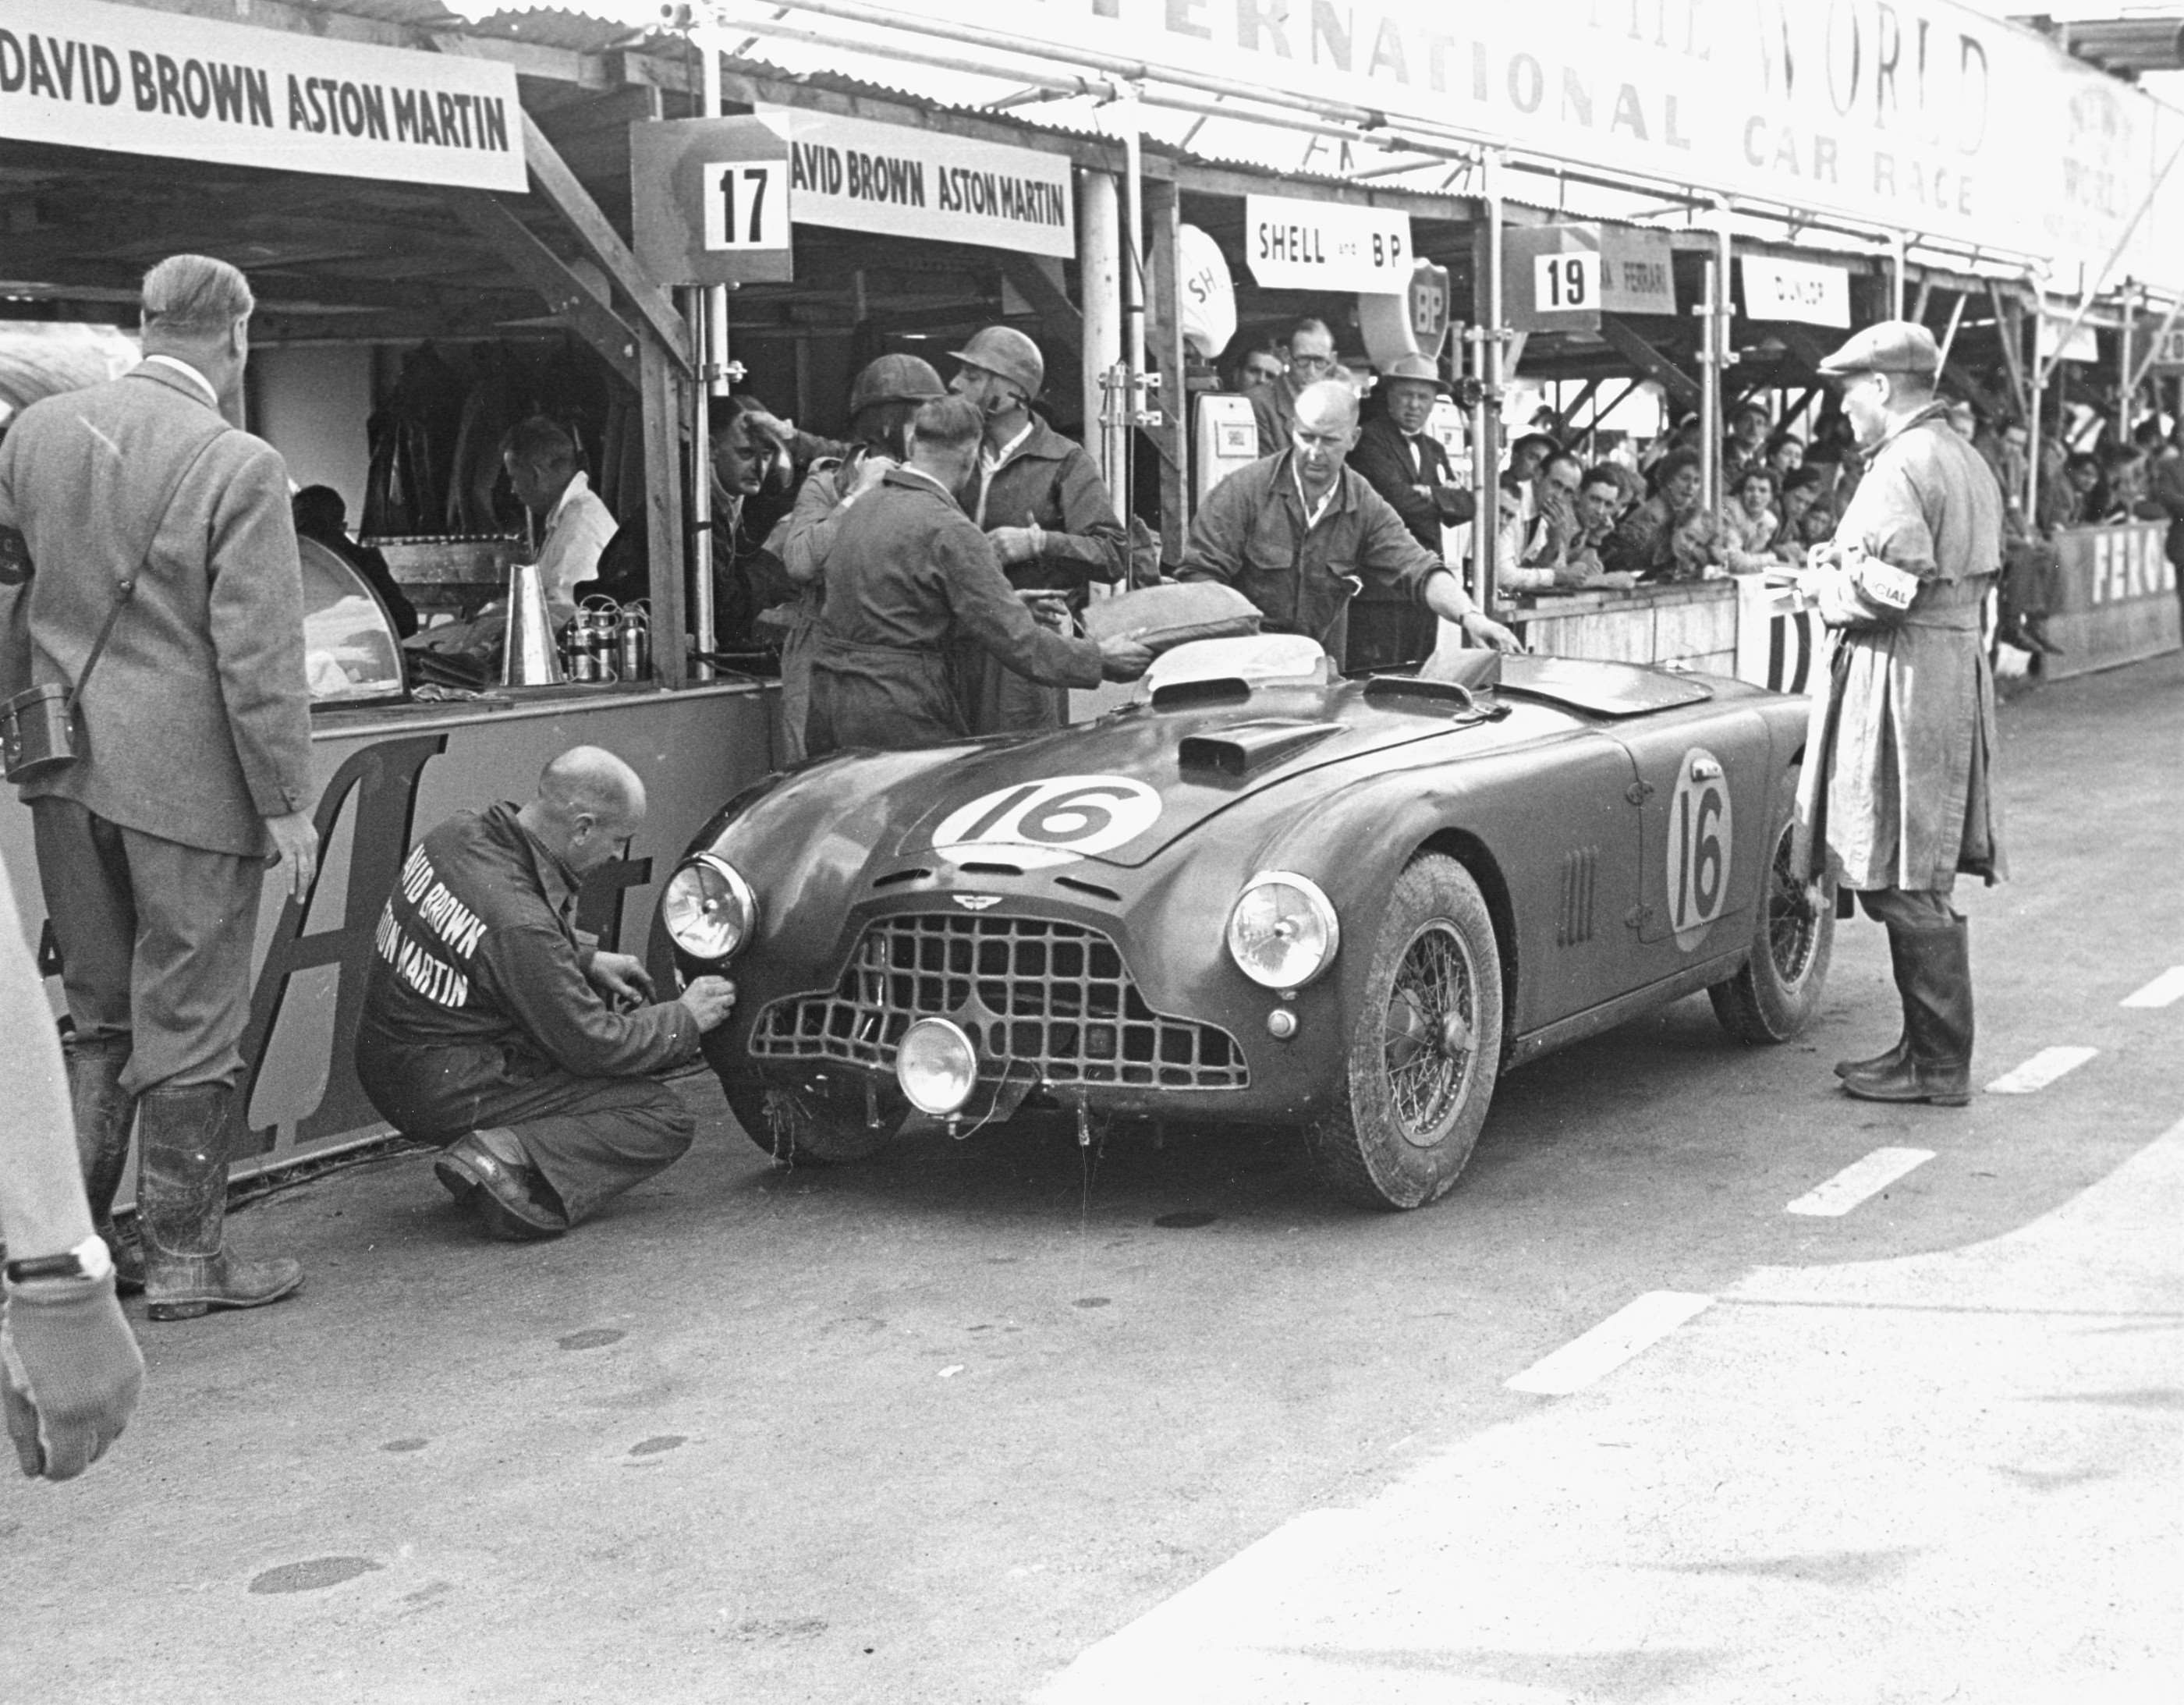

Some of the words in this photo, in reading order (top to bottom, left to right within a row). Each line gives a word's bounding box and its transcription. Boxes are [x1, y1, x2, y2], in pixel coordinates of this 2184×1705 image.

[0, 28, 122, 106] DAVID
[129, 50, 274, 129] BROWN
[287, 73, 391, 141] ASTON
[390, 86, 509, 152] MARTIN
[1090, 0, 1692, 151] ERNATIONAL
[1743, 115, 1840, 185] CAR
[1872, 150, 1974, 217] RACE
[719, 168, 768, 243] 17
[791, 140, 842, 195] AVID
[846, 150, 926, 208] BROWN
[938, 165, 999, 217] ASTON
[998, 175, 1066, 226] MARTIN
[1259, 222, 1326, 264] SHELL
[1413, 284, 1444, 335] BP
[1546, 258, 1585, 307] 19
[956, 784, 1142, 844] 16
[1676, 786, 1723, 928] 16
[402, 842, 434, 904] AVID
[418, 881, 488, 959] BROWN
[396, 934, 469, 1008] MARTIN
